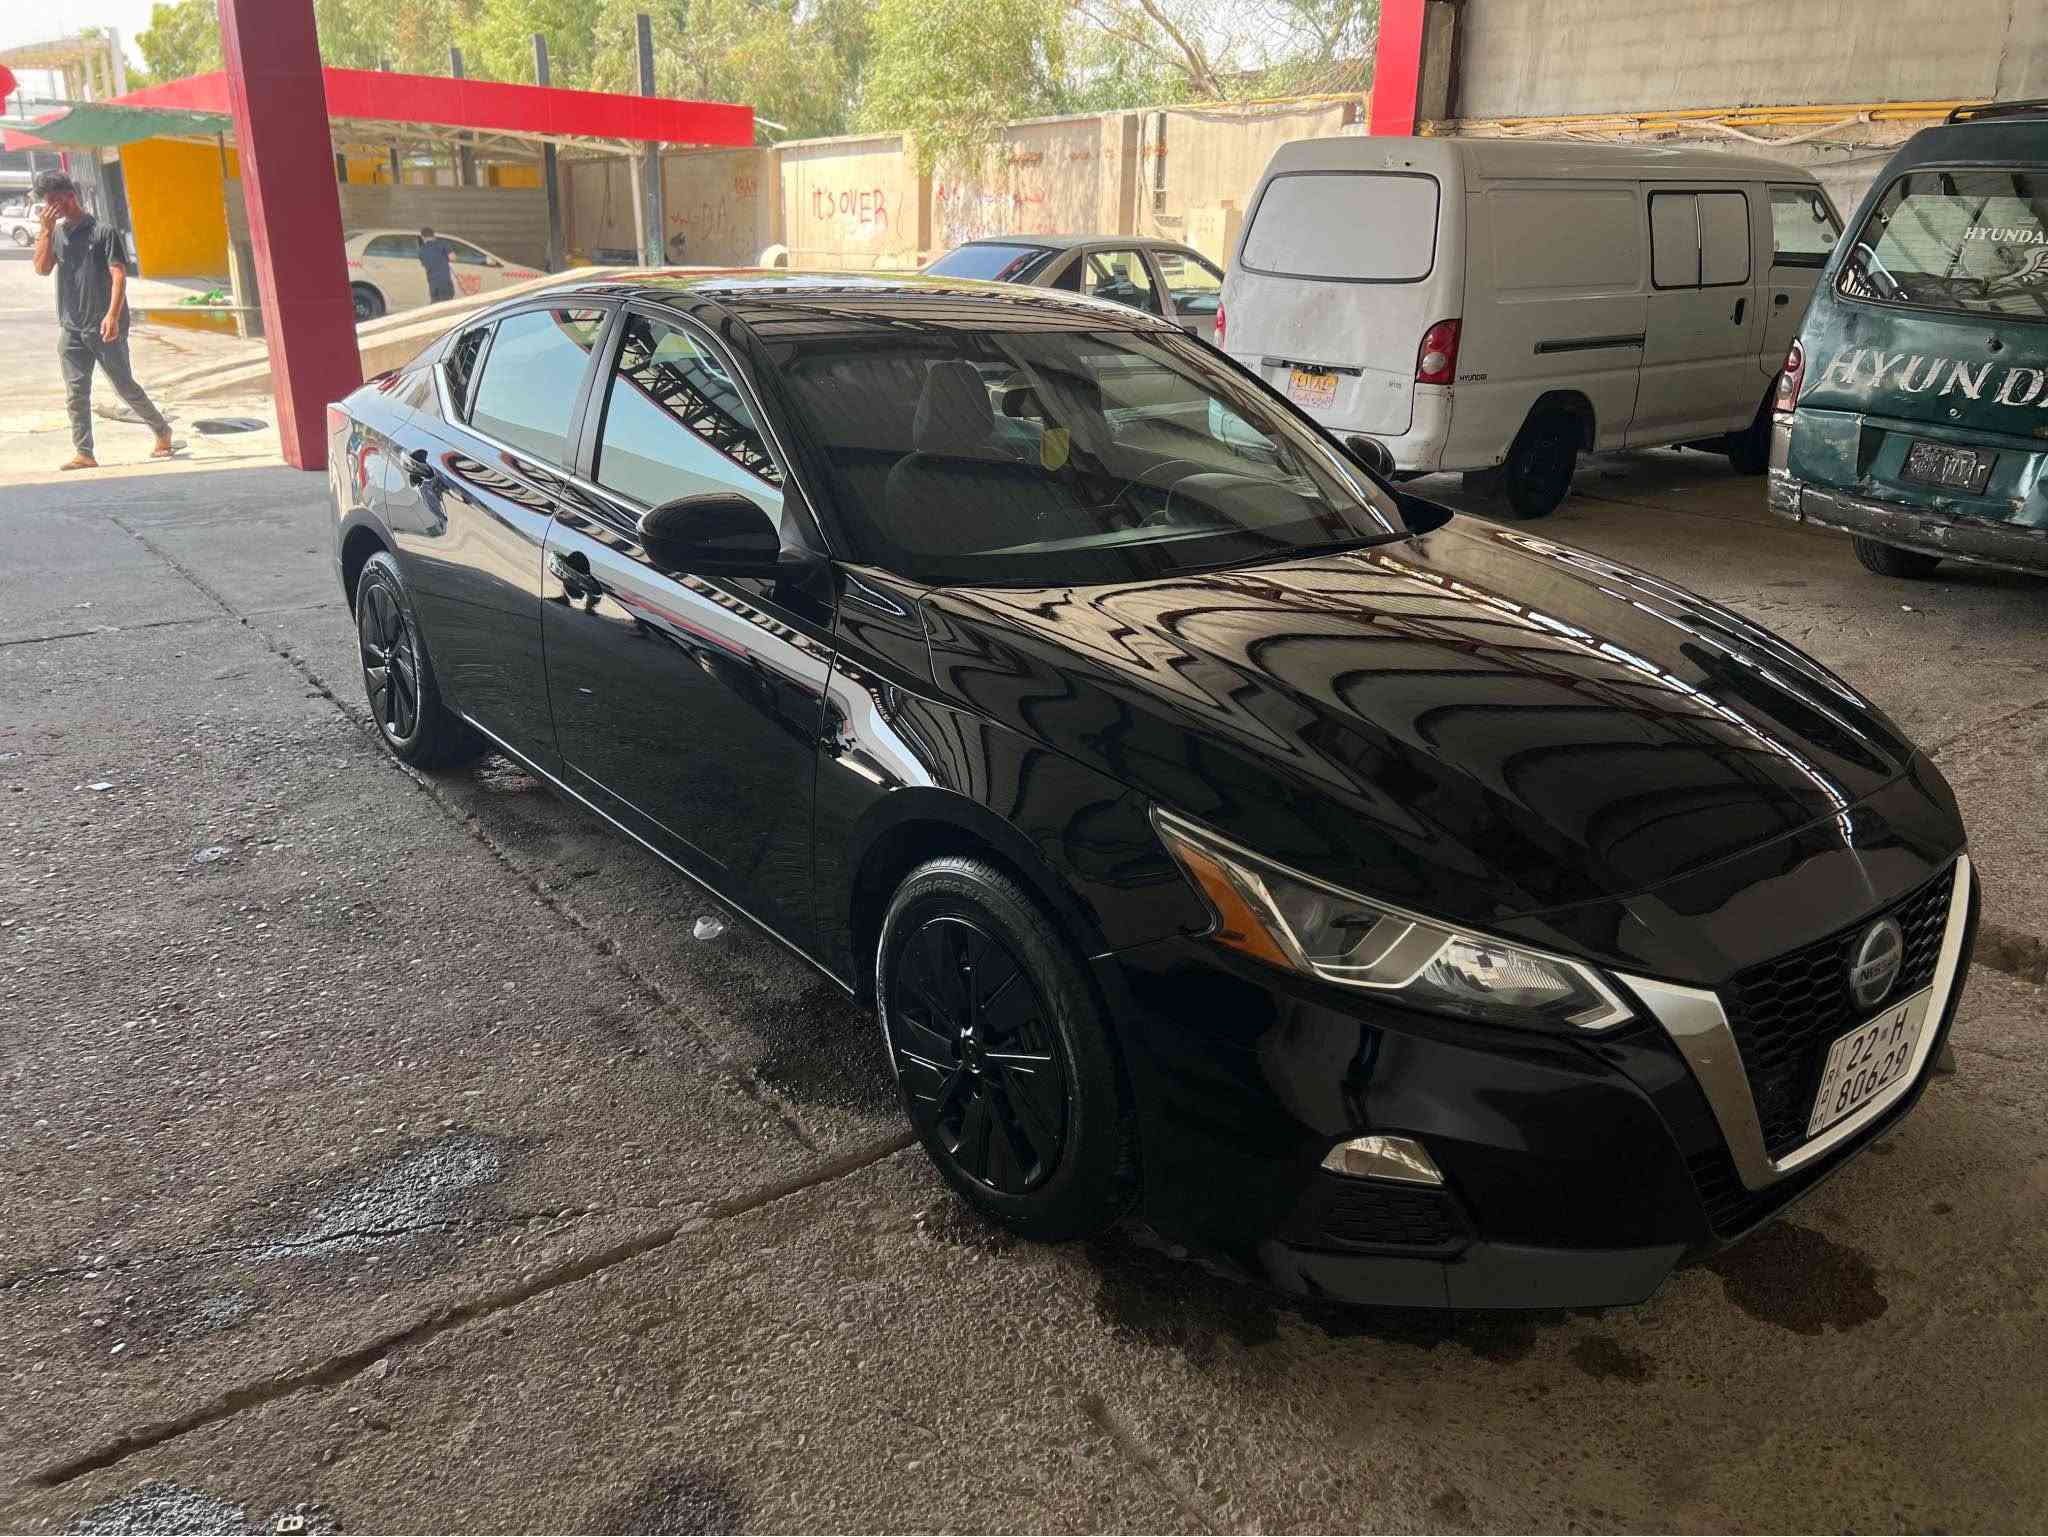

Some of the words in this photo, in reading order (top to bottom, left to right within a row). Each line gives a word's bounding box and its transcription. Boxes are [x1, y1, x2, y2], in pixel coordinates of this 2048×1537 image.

[839, 189, 888, 229] OVER
[1964, 227, 2048, 245] HYUNDA
[1836, 1042, 1908, 1113] 80629
